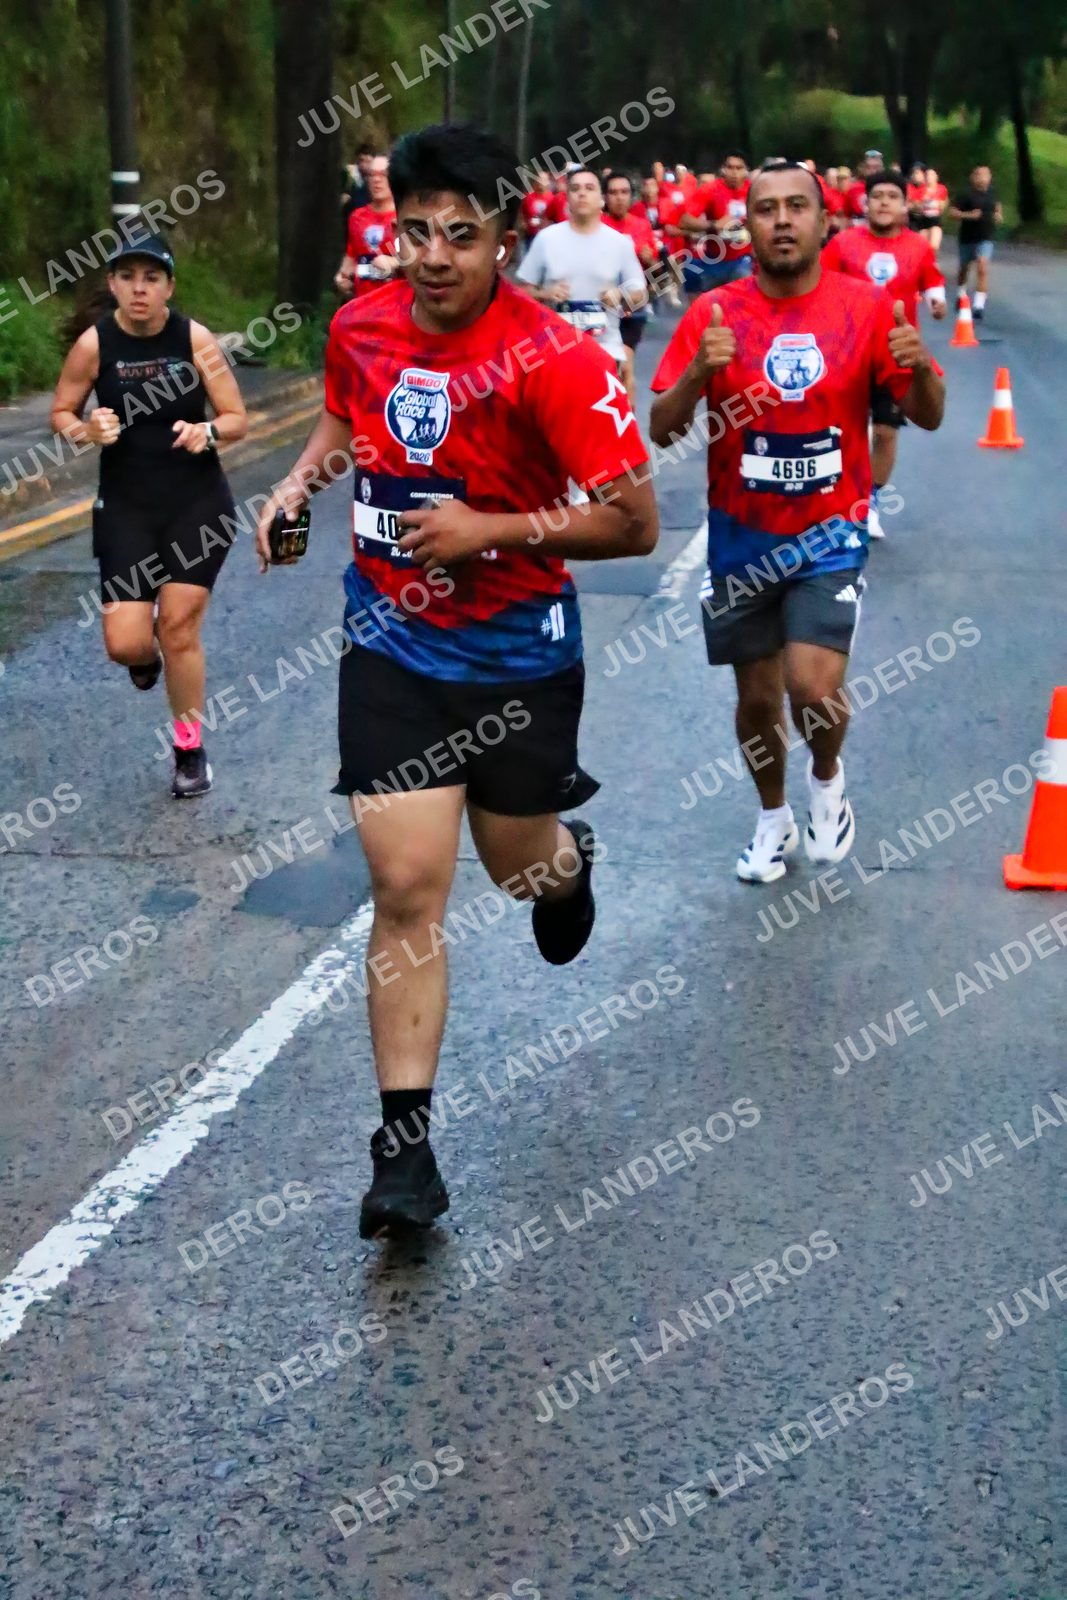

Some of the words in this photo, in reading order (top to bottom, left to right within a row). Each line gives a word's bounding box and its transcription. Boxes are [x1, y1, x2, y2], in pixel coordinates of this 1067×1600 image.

[407, 375, 441, 388] BIMBO
[404, 390, 437, 407] Global
[395, 402, 426, 419] Race
[772, 459, 816, 480] 4696
